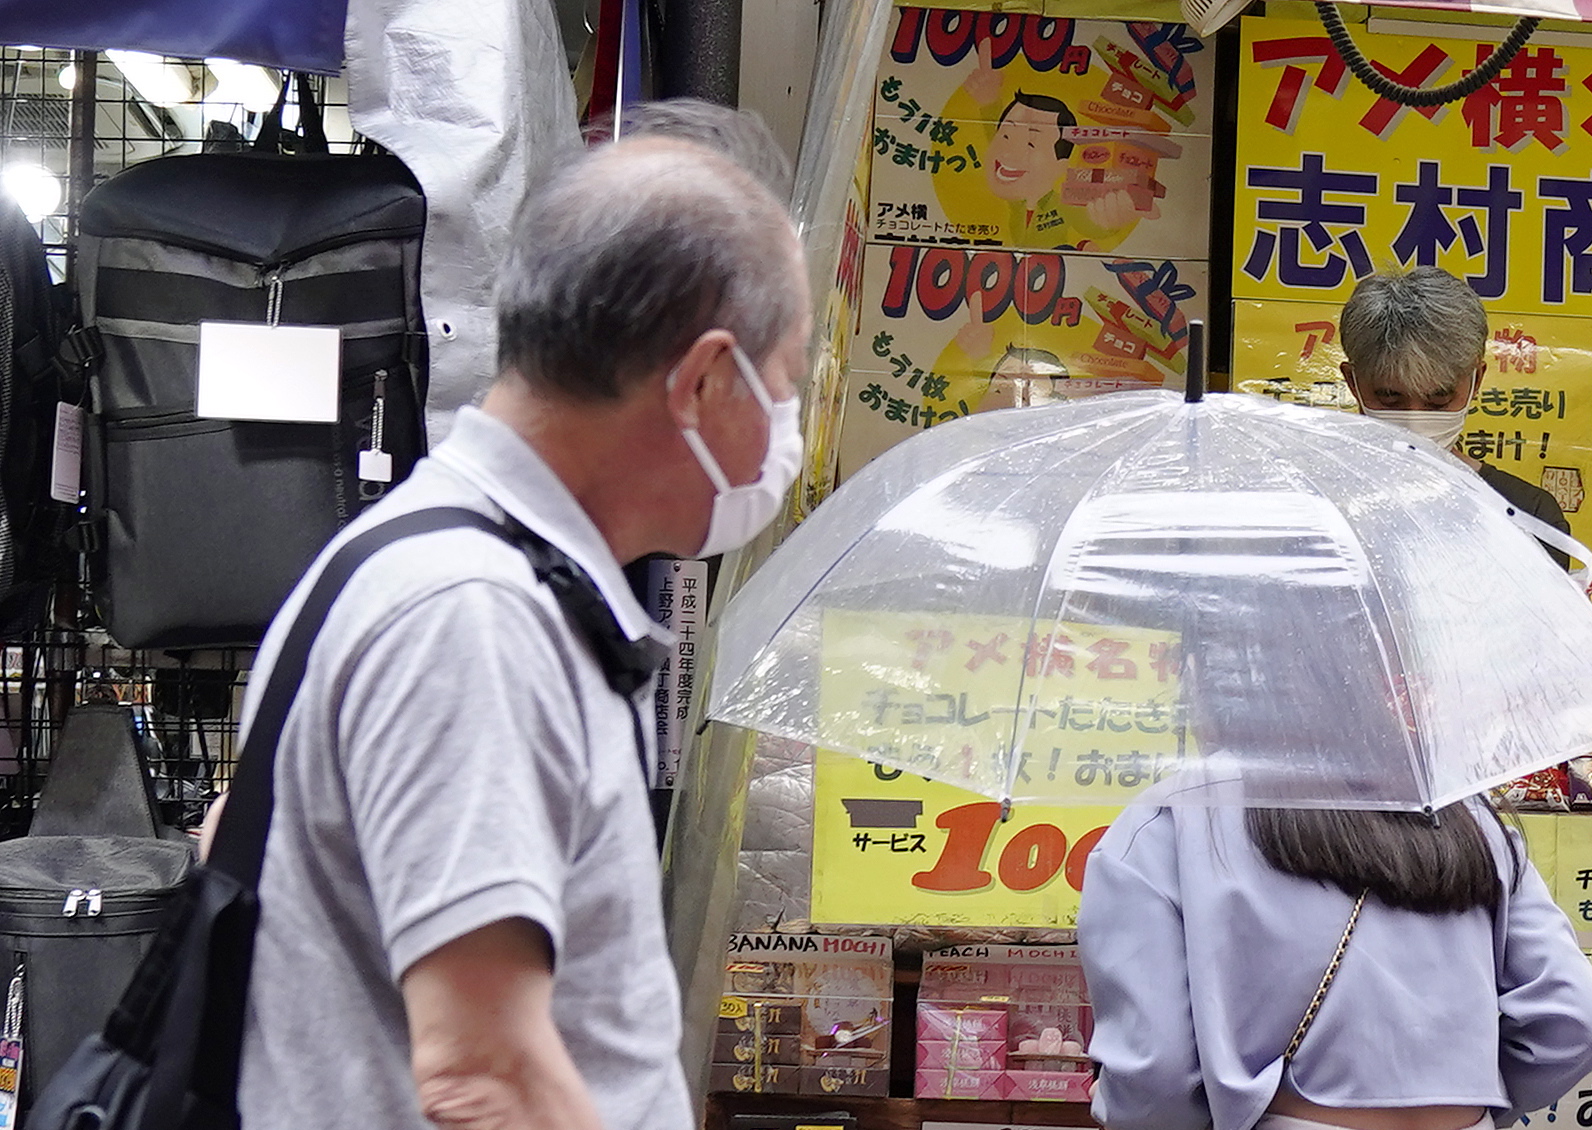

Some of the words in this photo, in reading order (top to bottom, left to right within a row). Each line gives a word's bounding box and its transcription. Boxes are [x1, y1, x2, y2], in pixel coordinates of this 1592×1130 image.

[1071, 127, 1131, 138] チョコレート
[877, 202, 928, 220] アメ横
[876, 218, 1000, 236] チョコレートたたき売り
[880, 246, 1083, 327] 1000円
[852, 832, 928, 855] サービス
[822, 936, 887, 956] MOCHI
[1007, 948, 1080, 959] MOCHI
